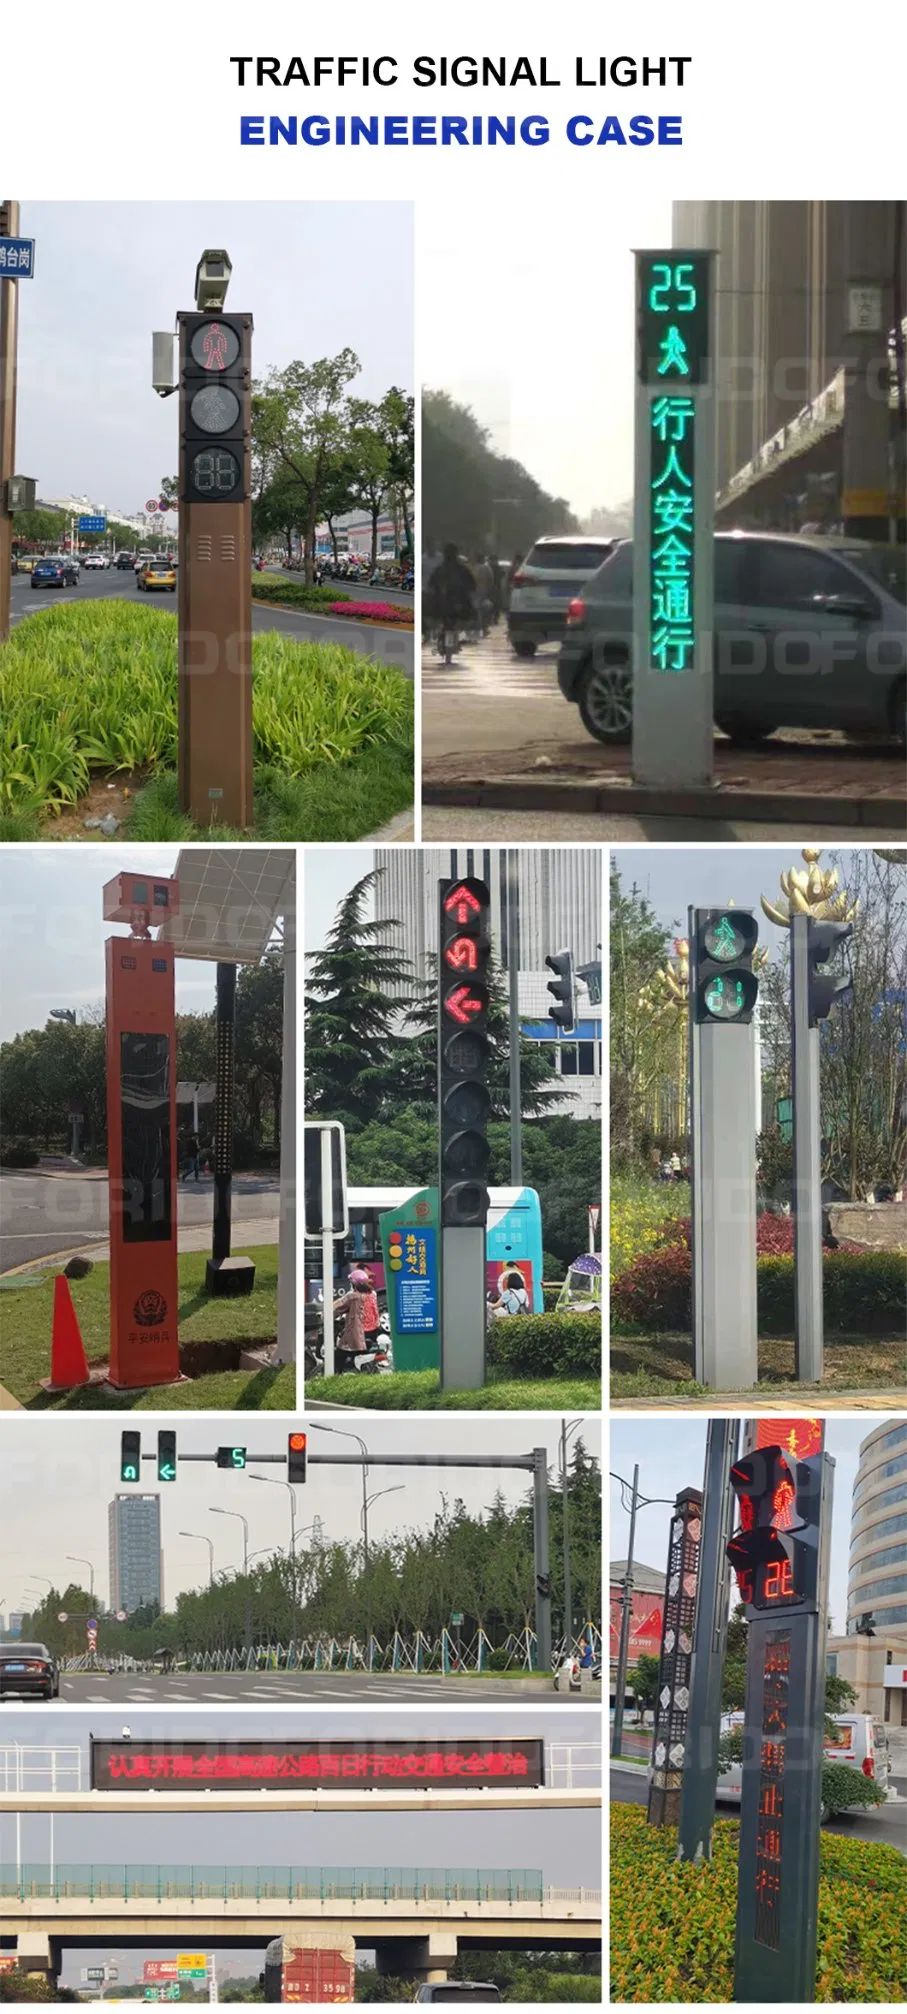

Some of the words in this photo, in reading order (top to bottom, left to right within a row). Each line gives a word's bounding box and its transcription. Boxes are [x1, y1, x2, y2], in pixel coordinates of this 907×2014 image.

[650, 264, 697, 312] 25
[650, 397, 695, 671] 行人安全通行
[706, 976, 745, 1012] 21
[232, 1448, 245, 1468] 5
